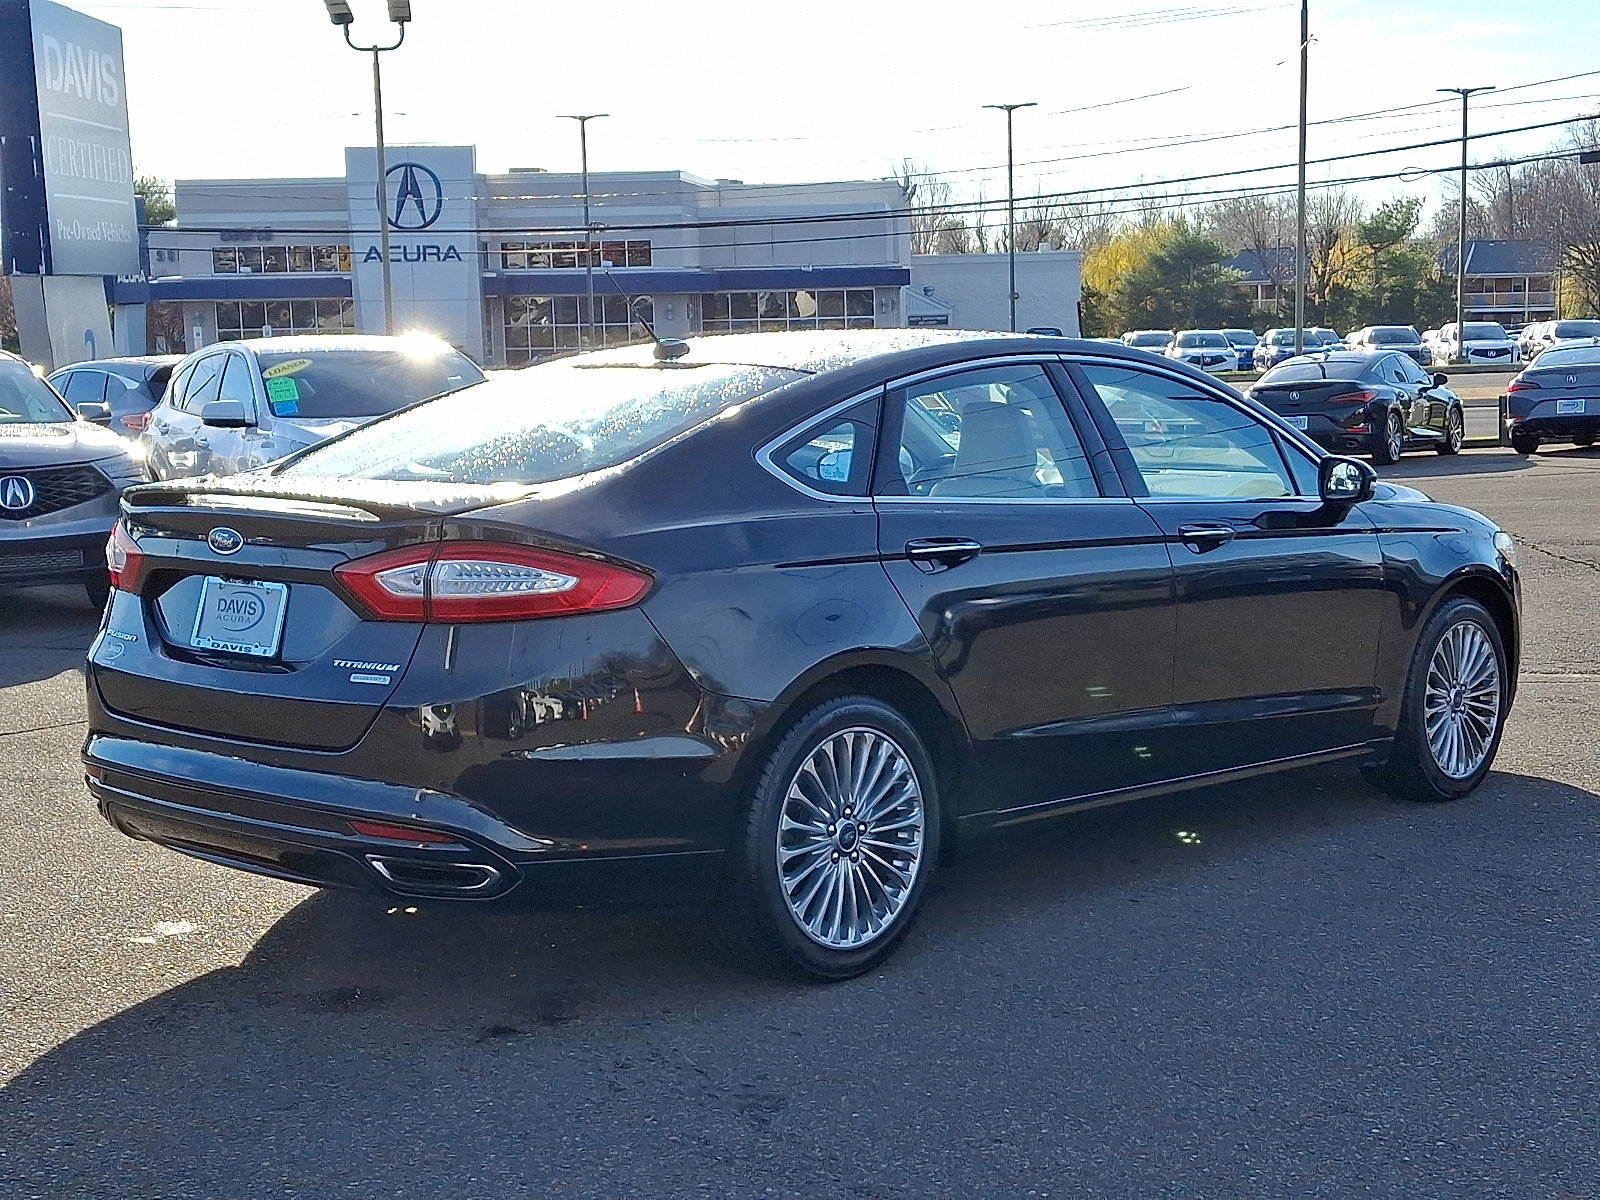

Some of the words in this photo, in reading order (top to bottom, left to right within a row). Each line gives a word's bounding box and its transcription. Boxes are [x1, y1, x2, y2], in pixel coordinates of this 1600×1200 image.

[43, 33, 119, 107] DAVIS
[47, 135, 129, 184] CERTIFIED
[56, 218, 101, 241] Pre-Owned
[102, 221, 132, 243] Vehicles
[363, 245, 462, 263] ACURA
[217, 597, 258, 616] DAVIS
[215, 613, 252, 625] ACURA
[210, 642, 253, 653] DAVIS
[333, 659, 401, 671] TITANIUM
